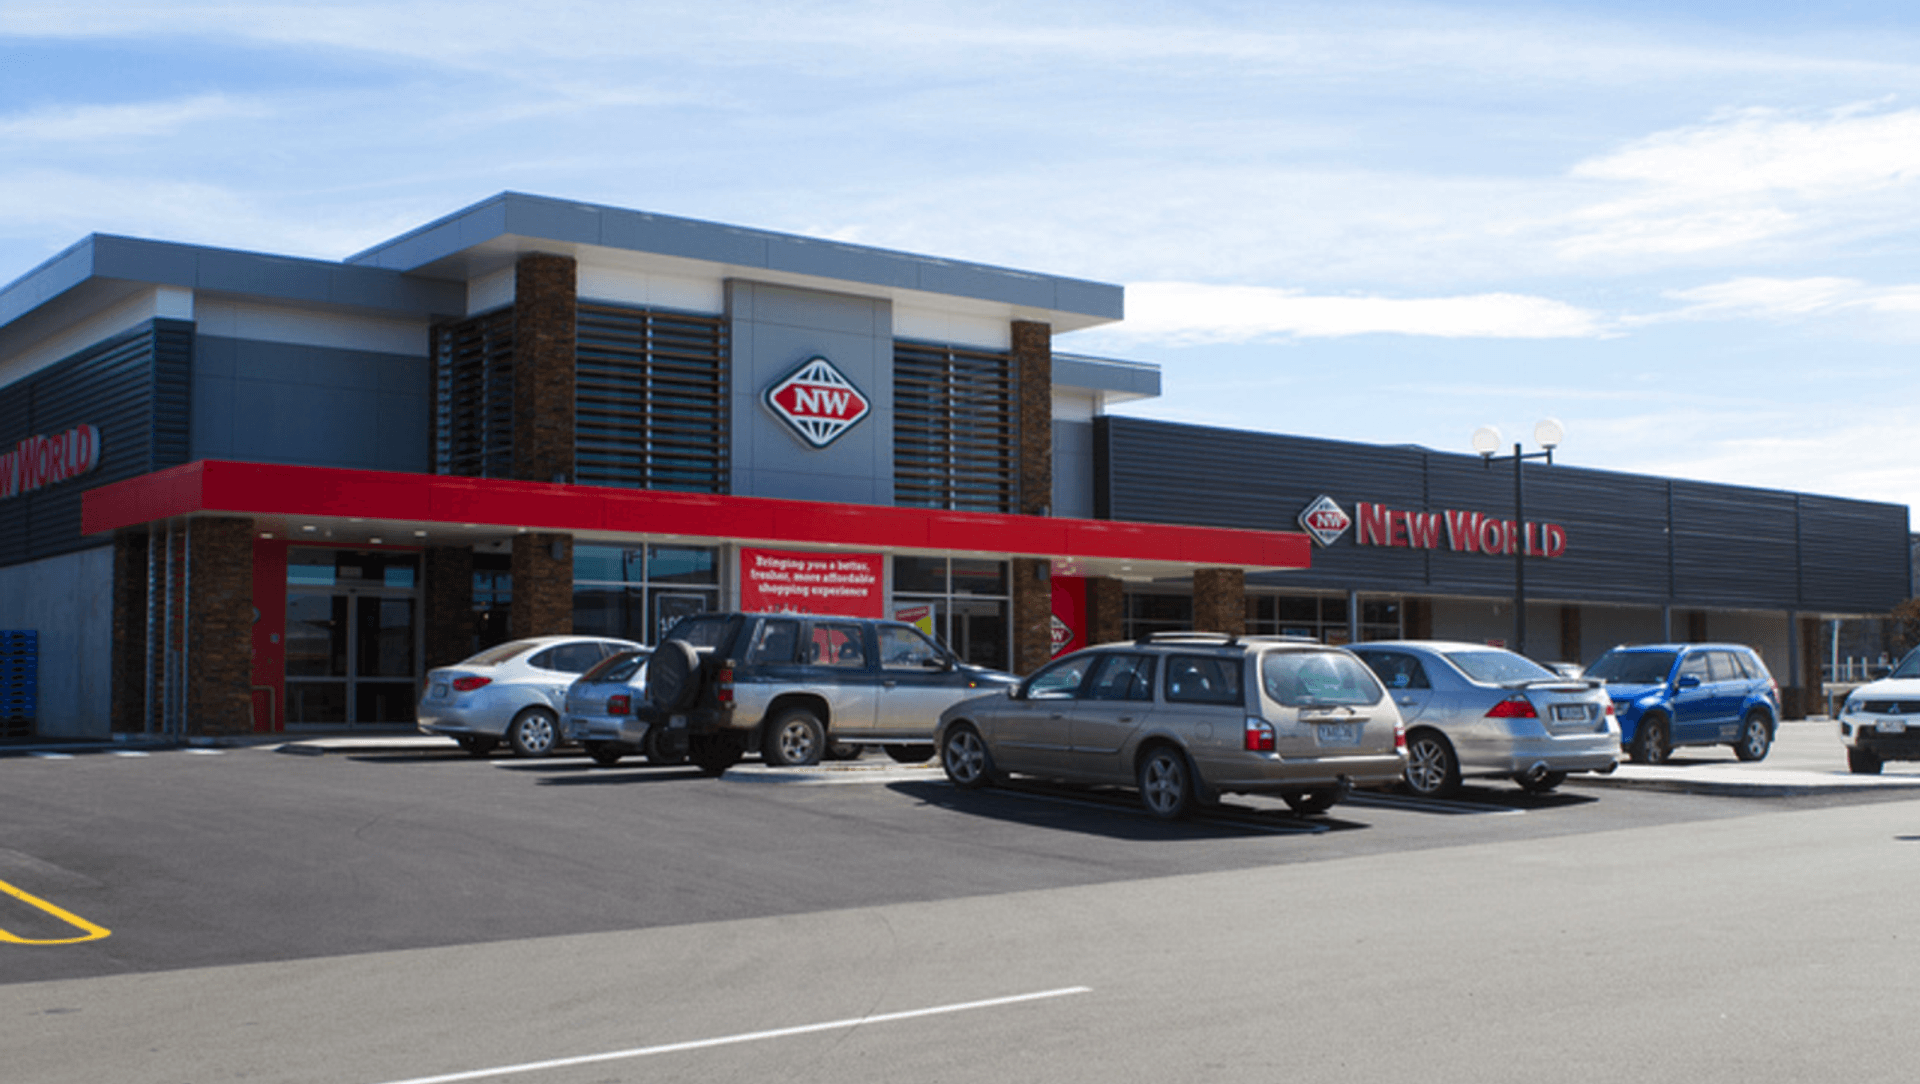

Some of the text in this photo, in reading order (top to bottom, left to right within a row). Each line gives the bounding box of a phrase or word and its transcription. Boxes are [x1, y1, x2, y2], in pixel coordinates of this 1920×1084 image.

[793, 387, 850, 416] NW
[17, 423, 97, 493] WORLD
[1315, 513, 1342, 528] NW
[1355, 502, 1567, 557] NEW WORLD
[755, 555, 805, 570] Bringing
[806, 561, 827, 571] you
[793, 573, 821, 582] more
[823, 572, 876, 583] affordable
[758, 582, 868, 597] shopping experience
